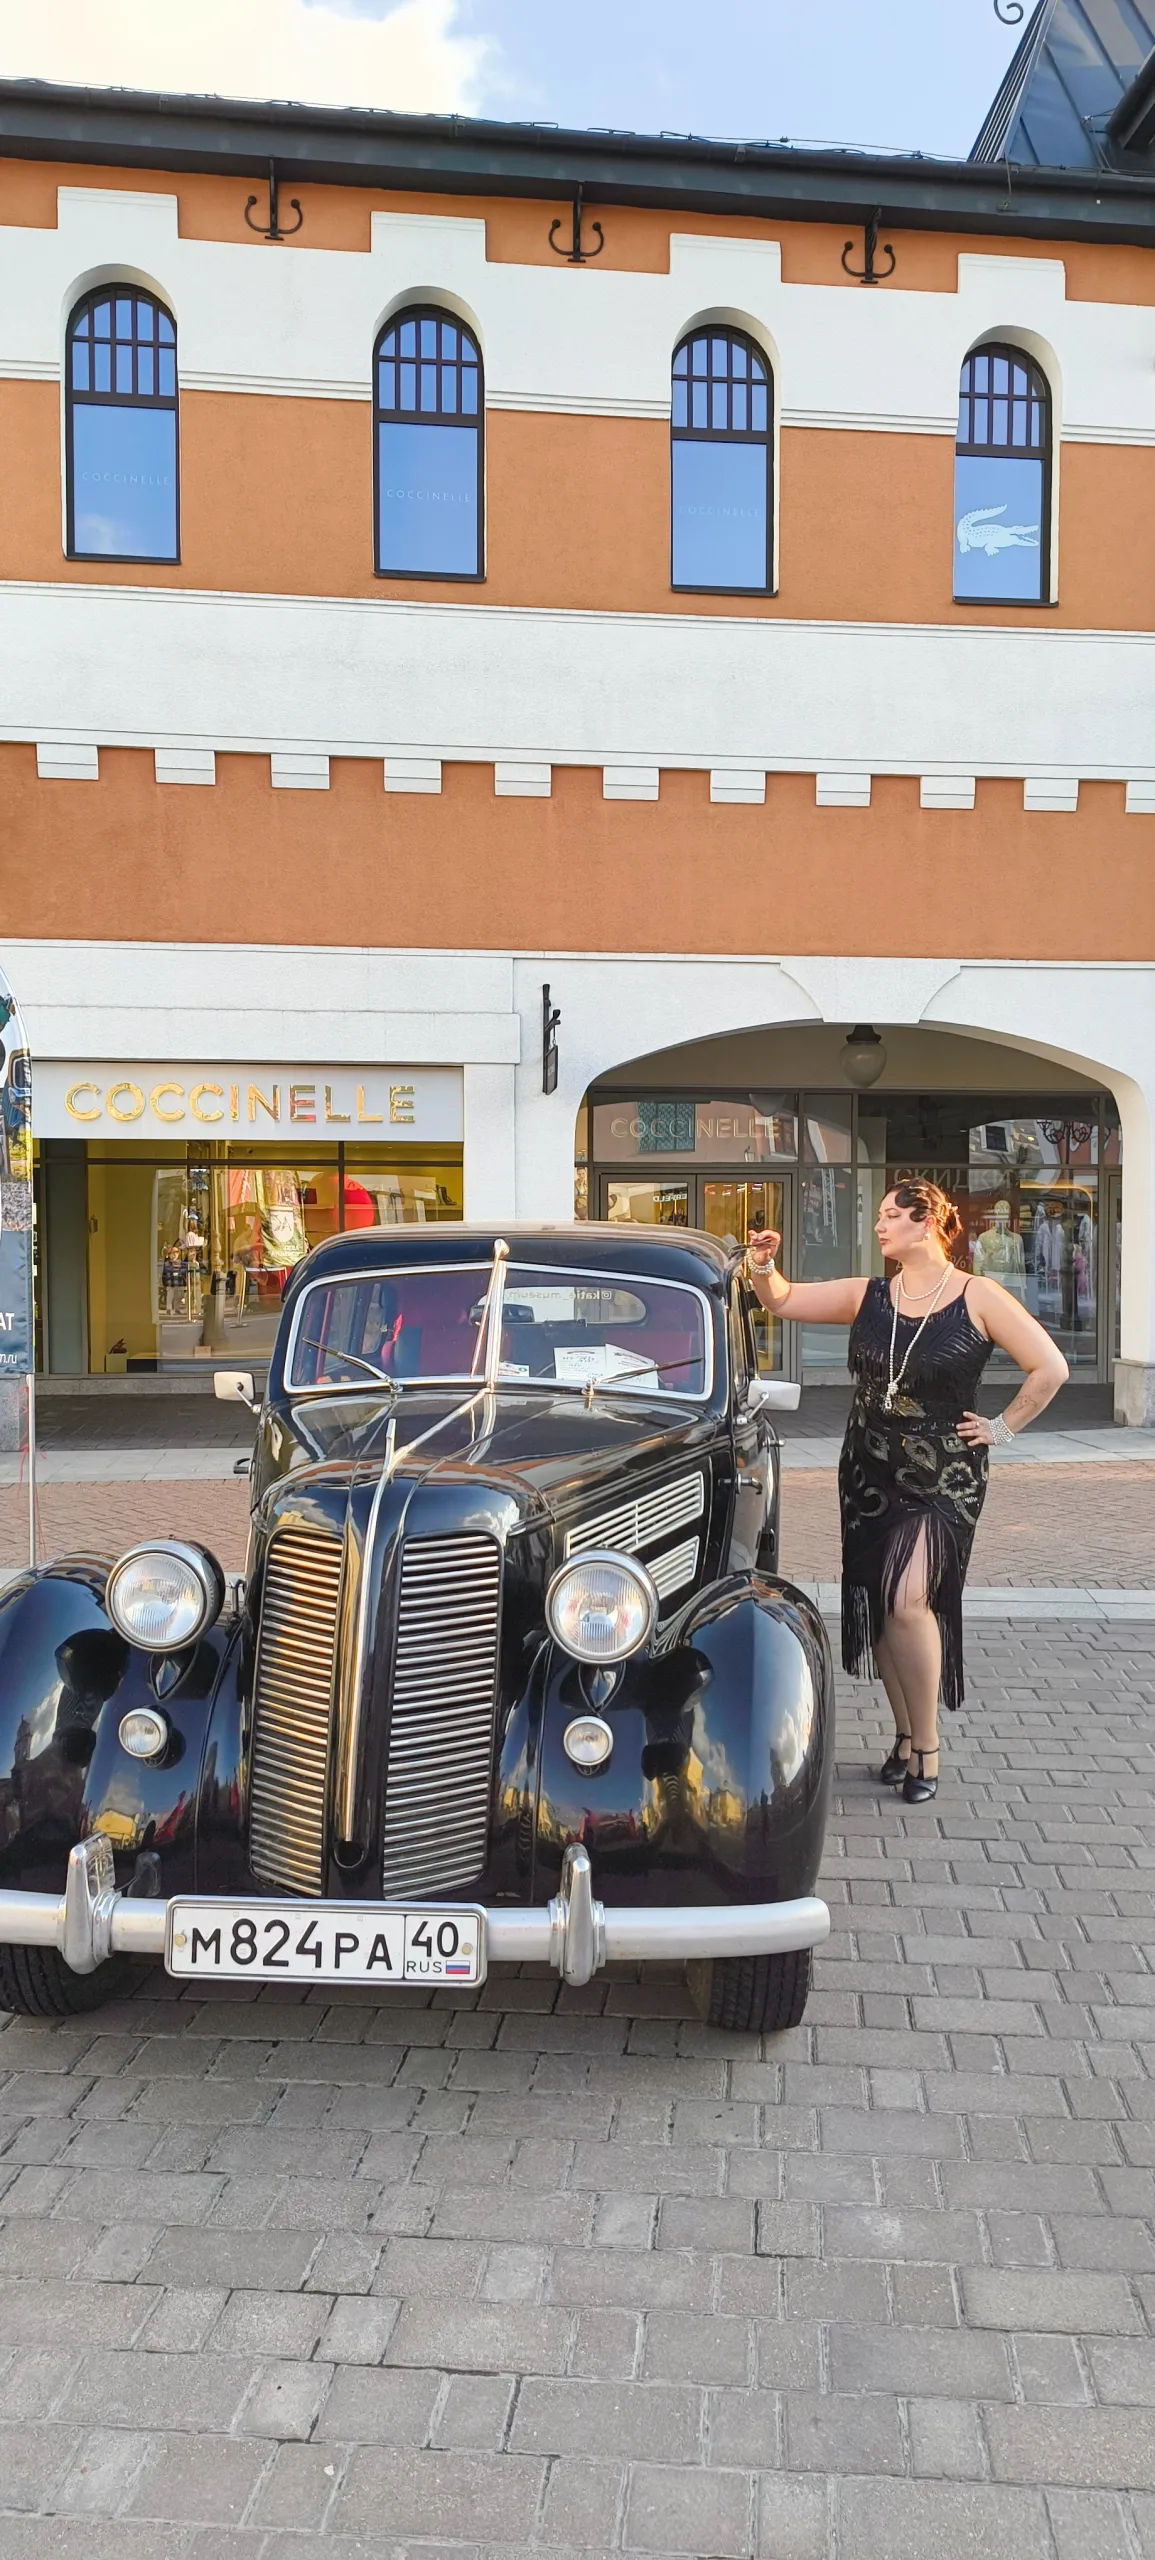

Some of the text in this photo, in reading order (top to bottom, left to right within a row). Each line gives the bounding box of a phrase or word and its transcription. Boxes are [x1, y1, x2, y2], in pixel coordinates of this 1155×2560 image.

[82, 472, 169, 486] COCCINELLE
[386, 489, 469, 502] COCCINELLE
[64, 1081, 416, 1123] COCCINELLE
[610, 1117, 781, 1139] COCCINELLE
[190, 1917, 459, 1971] М824РА 40
[406, 1960, 443, 1973] RUS
